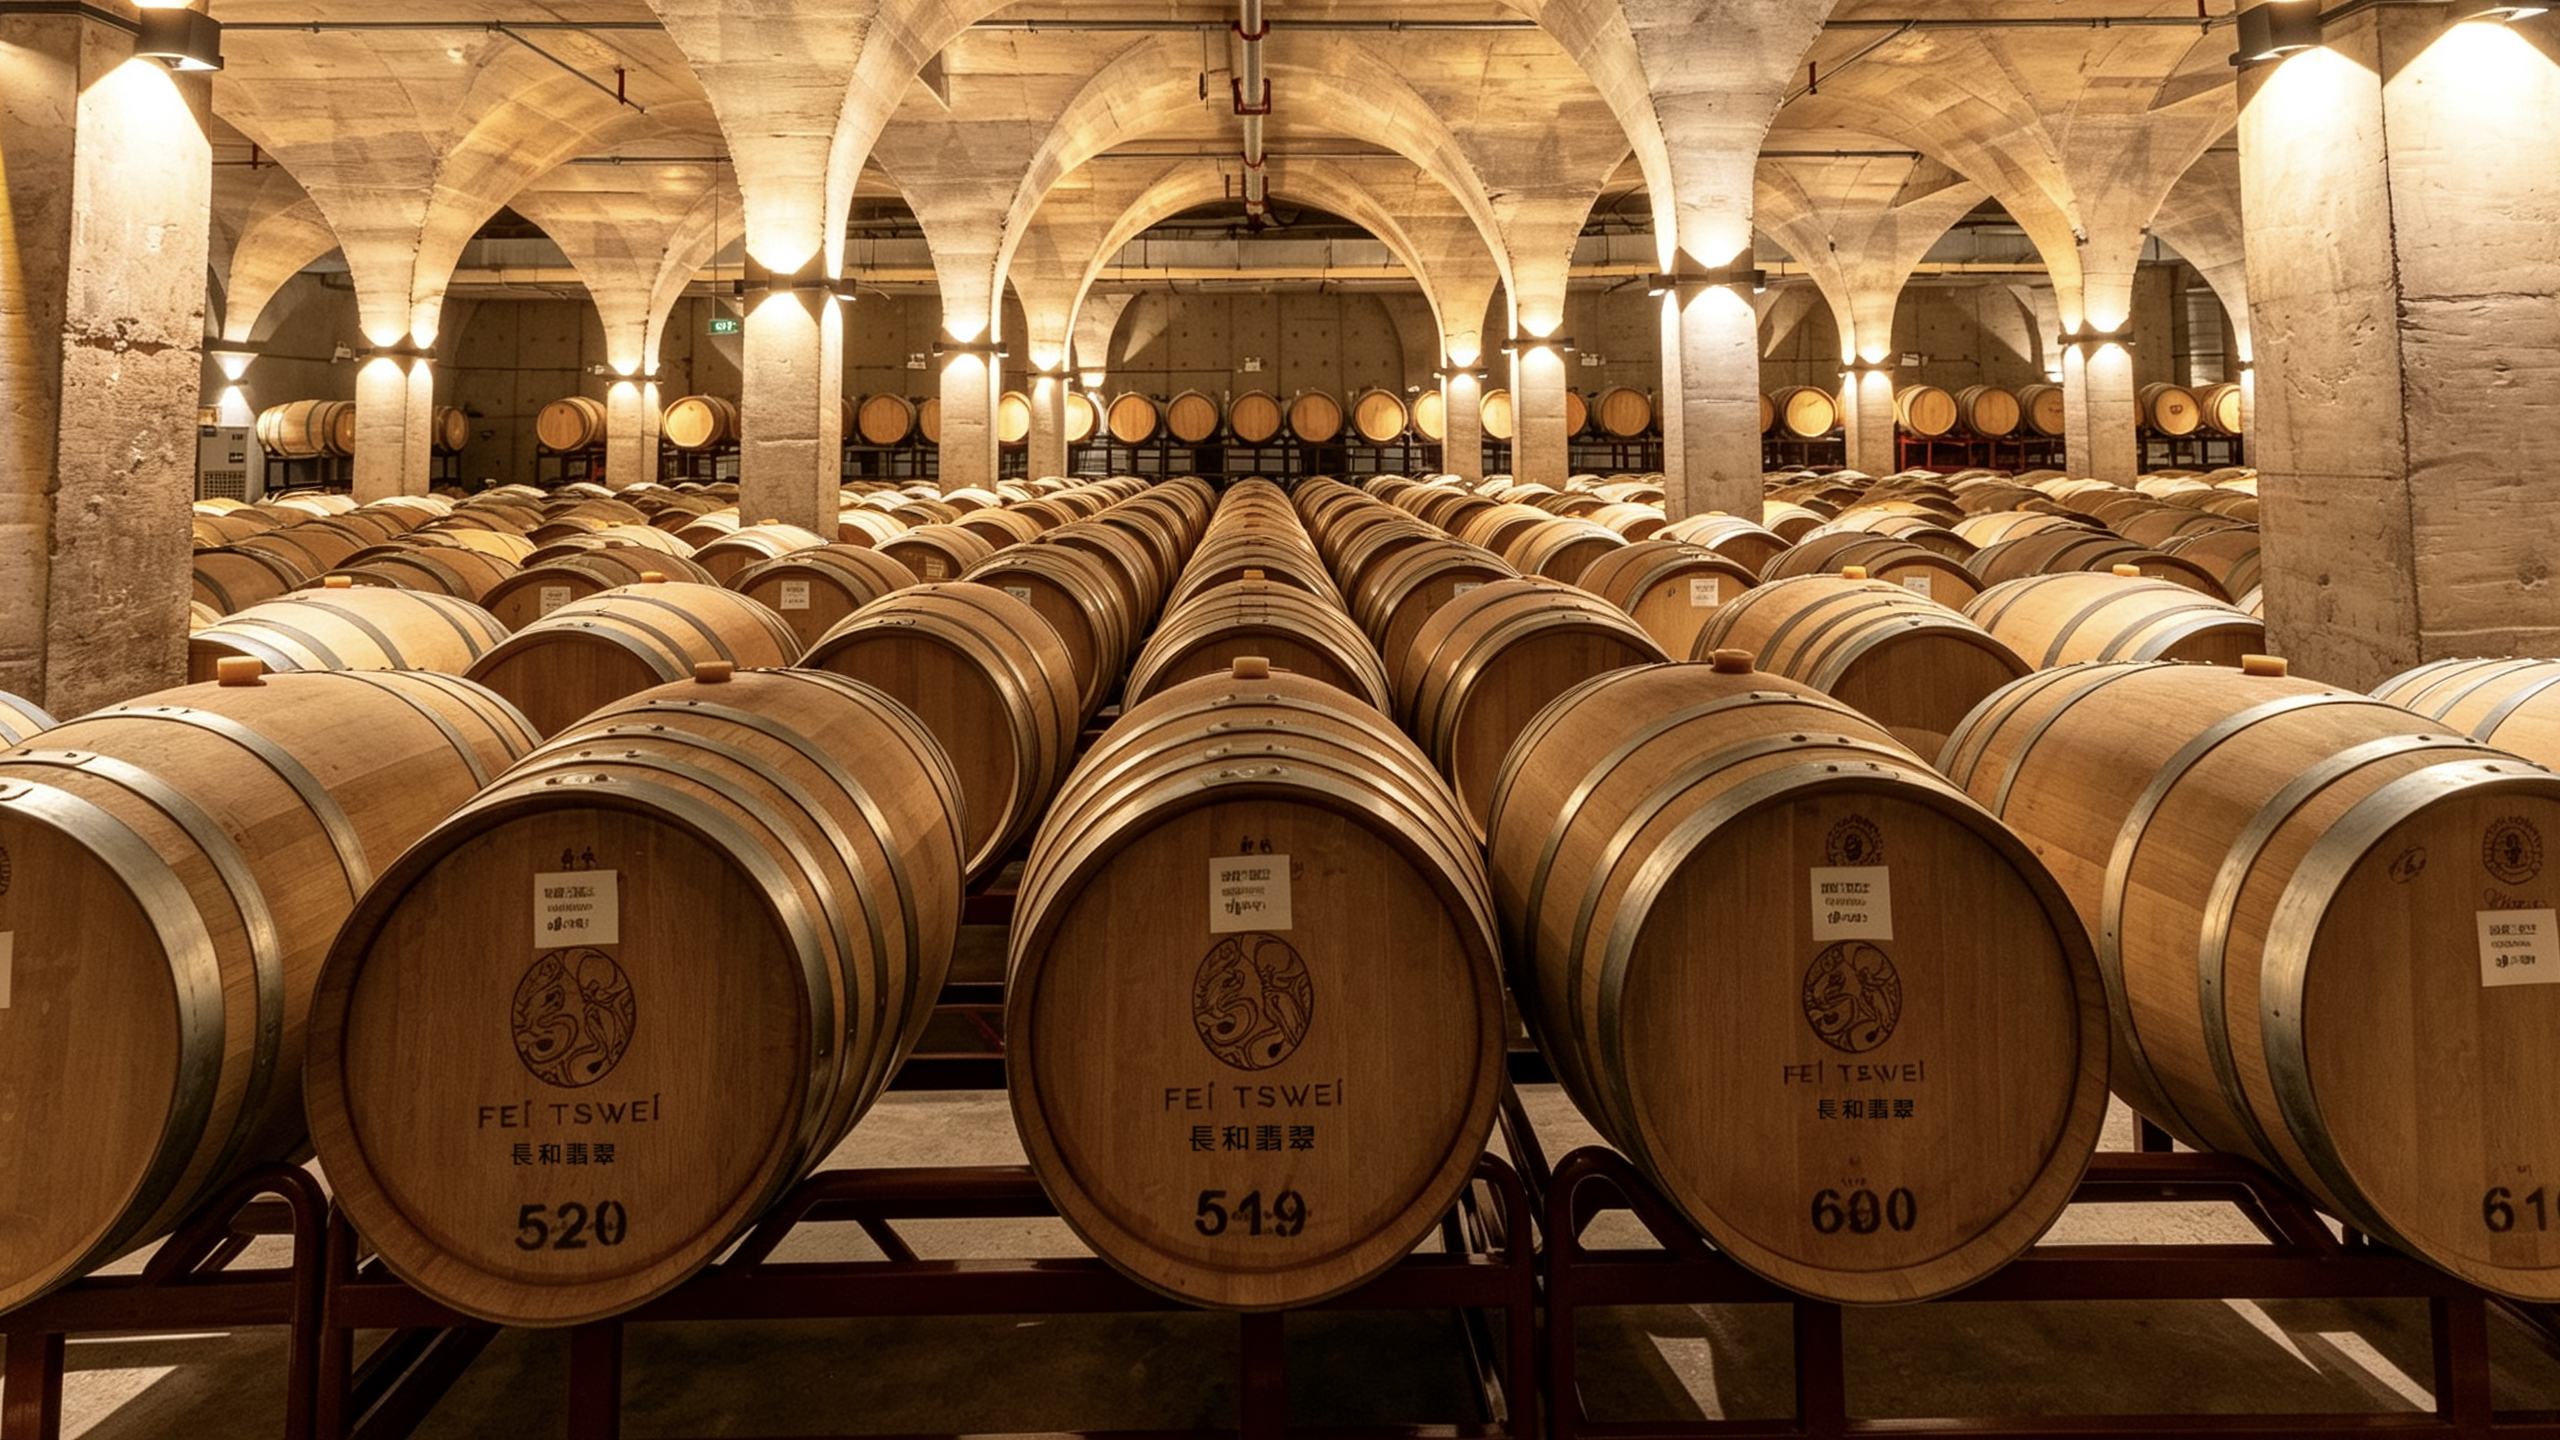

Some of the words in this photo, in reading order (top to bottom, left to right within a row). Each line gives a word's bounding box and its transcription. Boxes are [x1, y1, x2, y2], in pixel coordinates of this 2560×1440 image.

[1817, 1098, 1915, 1120] 長和翡翠
[510, 1143, 616, 1166] 長和翡翠
[1188, 1125, 1316, 1152] 長和翡翠
[514, 1200, 628, 1252] 520
[1194, 1189, 1308, 1238] 519
[2483, 1186, 2560, 1233] 61
